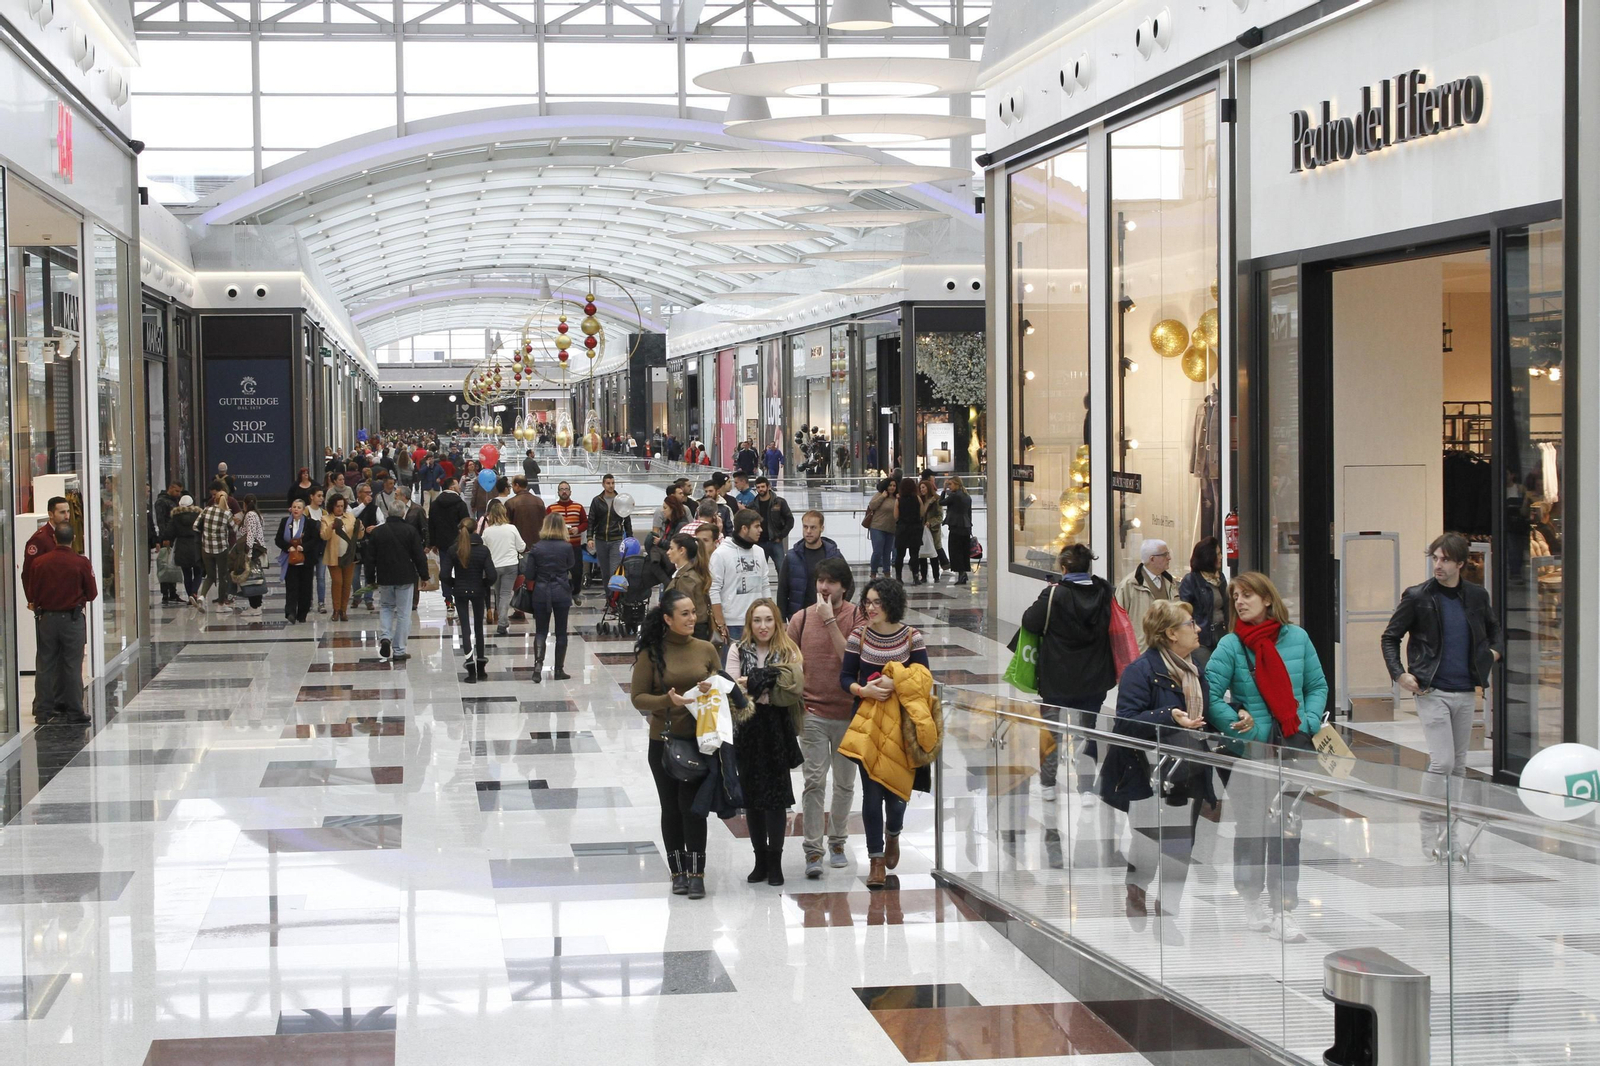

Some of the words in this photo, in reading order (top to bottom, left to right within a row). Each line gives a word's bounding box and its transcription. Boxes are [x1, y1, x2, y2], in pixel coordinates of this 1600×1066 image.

[1289, 100, 1354, 174] Pedro
[1353, 78, 1392, 156] del
[1391, 68, 1485, 146] Hierro
[218, 397, 280, 406] GUTTERIDGE
[232, 420, 267, 431] SHOP
[224, 432, 275, 444] ONLINE
